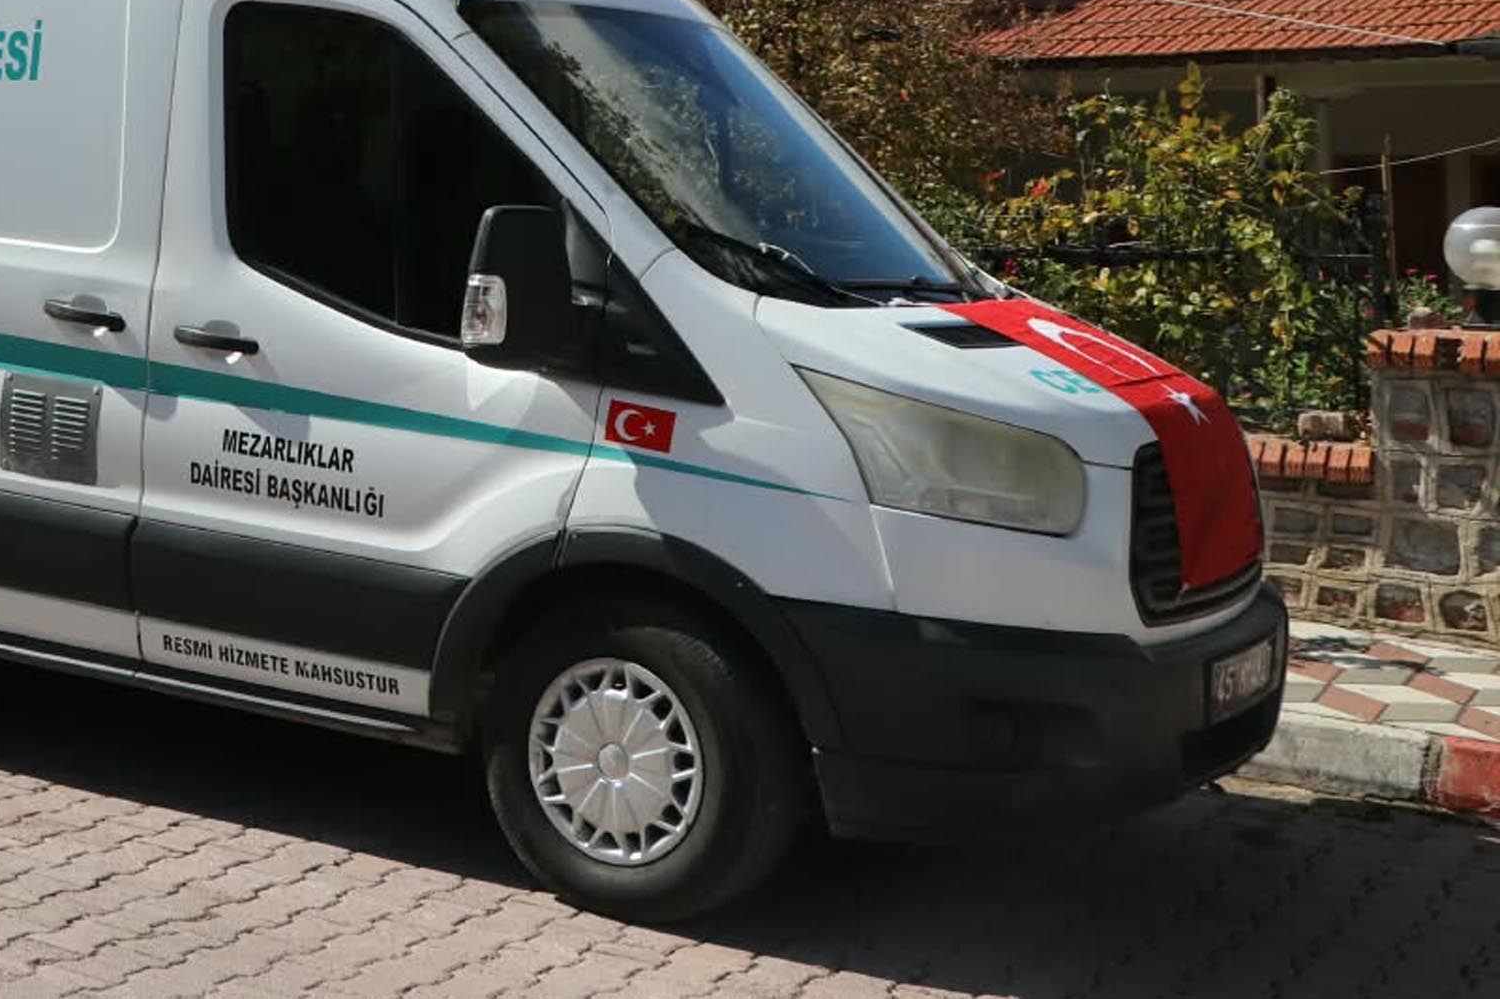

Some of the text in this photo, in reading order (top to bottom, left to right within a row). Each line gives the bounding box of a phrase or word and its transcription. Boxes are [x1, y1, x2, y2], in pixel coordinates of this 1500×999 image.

[222, 429, 355, 473] MEZARLIKLAR
[190, 460, 384, 517] DAİRESİ BAŞKANLIĞI
[219, 644, 289, 675] HİZMETE
[295, 661, 400, 695] MAHSUSTUR
